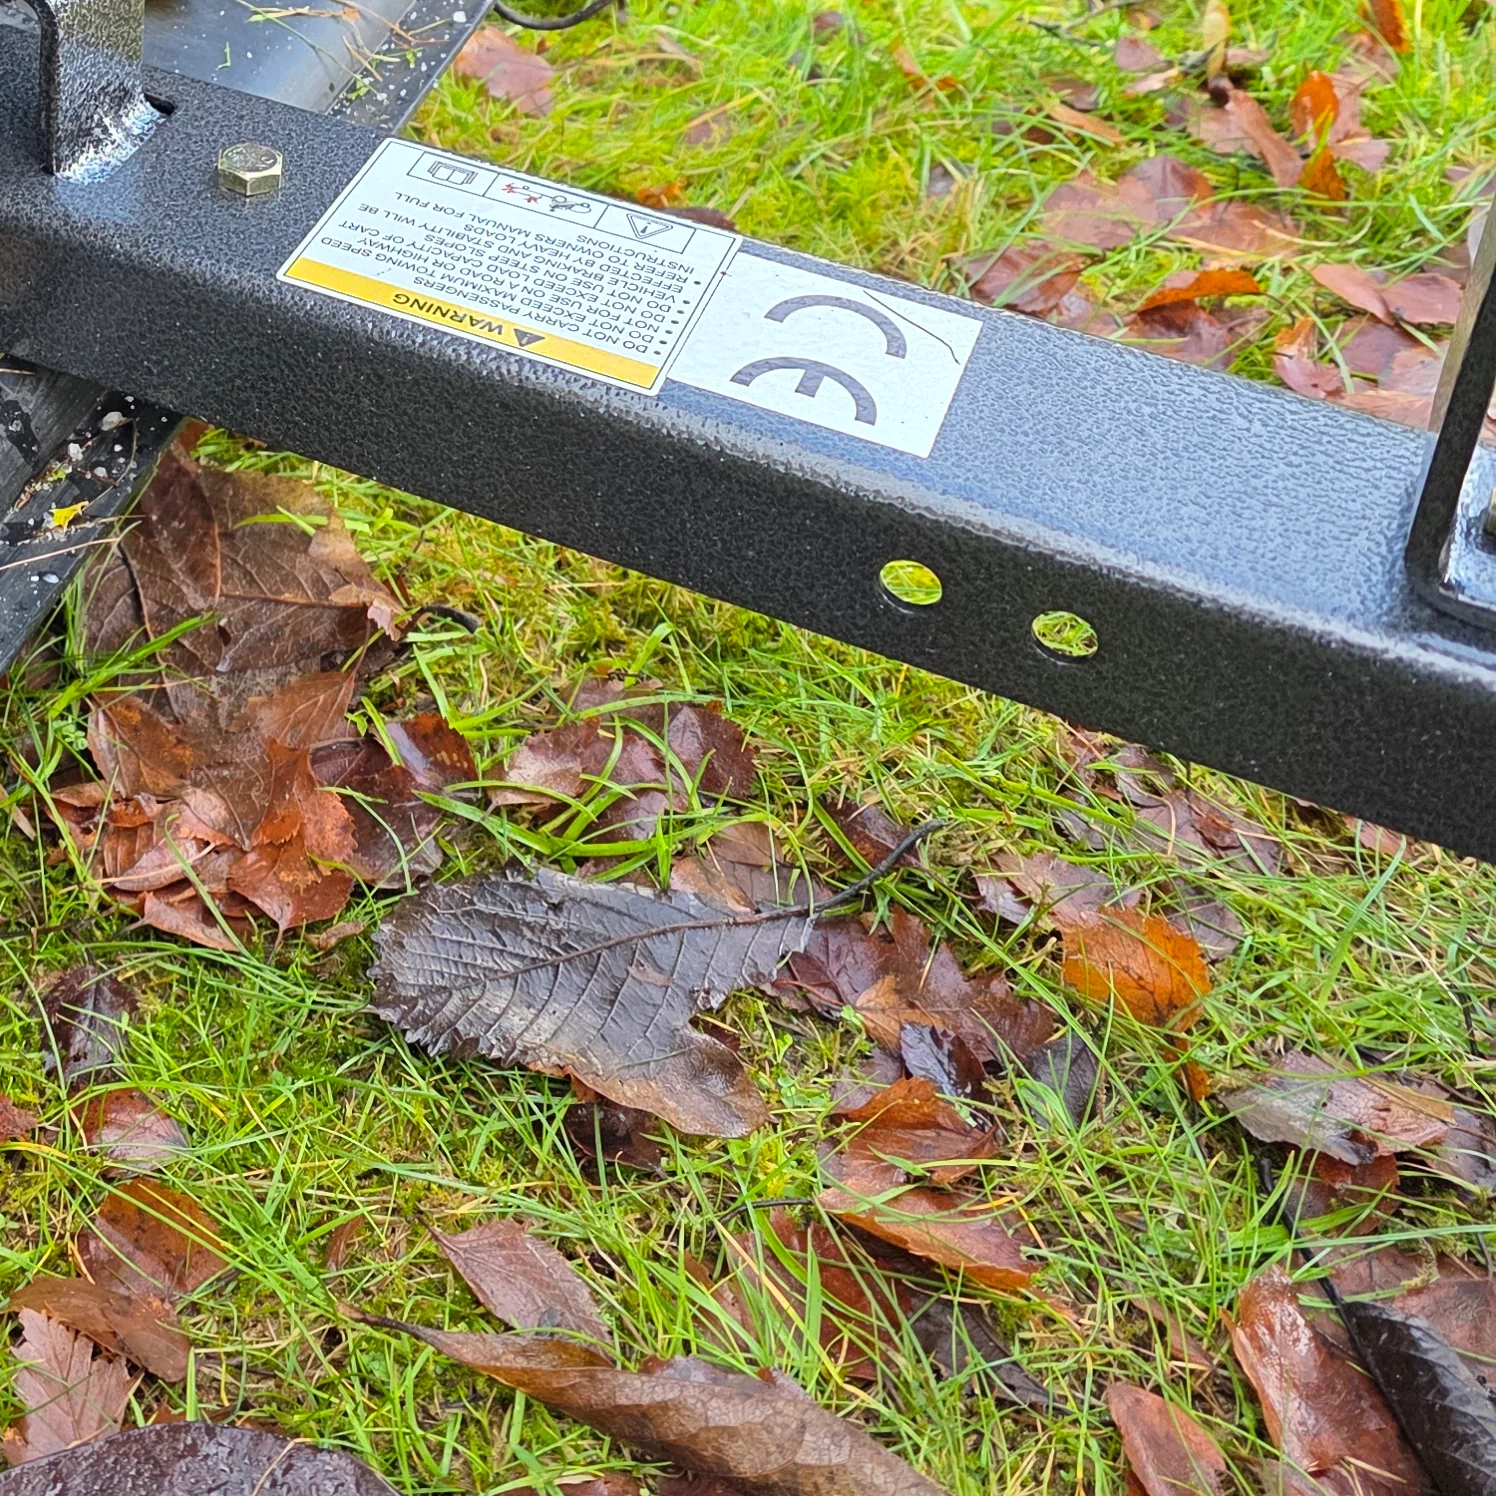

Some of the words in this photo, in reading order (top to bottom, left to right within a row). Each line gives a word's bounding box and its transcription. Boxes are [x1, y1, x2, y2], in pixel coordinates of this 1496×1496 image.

[395, 191, 430, 208] FULL
[358, 203, 380, 215] BE
[432, 203, 465, 219] FOR
[383, 210, 416, 227] WILL
[469, 213, 532, 238] MANUAL
[338, 220, 380, 237] CART
[417, 222, 495, 249] STABILITY
[463, 224, 516, 245] LOADS
[320, 236, 373, 257] SPEED
[381, 234, 405, 244] OF
[424, 234, 486, 257] SLOPES
[534, 233, 605, 259] OWNERS
[356, 237, 430, 264] HIGHWAY
[405, 240, 483, 268] CAPACITY
[497, 244, 533, 259] AND
[517, 240, 571, 261] HEAVY
[576, 234, 695, 275] INSTRUCTIONS
[374, 252, 436, 278] TOWING
[431, 258, 456, 271] OR
[488, 254, 541, 274] STEEP
[533, 255, 605, 282] BRAKING
[572, 256, 596, 268] BY
[607, 255, 629, 267] TO
[459, 267, 506, 286] ROAD
[486, 263, 530, 282] LOAD
[543, 269, 568, 282] ON
[598, 263, 684, 294] EFFECTED
[633, 261, 689, 284] REFER
[439, 272, 517, 302] MAXIMUM
[509, 280, 521, 290] A
[520, 285, 546, 298] ON
[533, 278, 600, 303] EXCEED
[570, 277, 605, 294] USE
[607, 276, 676, 304] VEHICLE
[413, 276, 521, 315] PASSENGERS
[548, 293, 583, 310] USE
[606, 289, 643, 305] NOT
[392, 293, 503, 336] WARNING
[520, 297, 587, 323] EXCEED
[586, 304, 622, 322] FOR
[600, 298, 638, 315] NOT
[646, 300, 672, 313] DO
[521, 310, 580, 332] CARRY
[622, 317, 661, 333] NOT
[640, 310, 666, 323] DO
[588, 318, 626, 335] NOT
[581, 328, 621, 345] NOT
[628, 330, 655, 344] DO
[622, 340, 649, 354] DO
